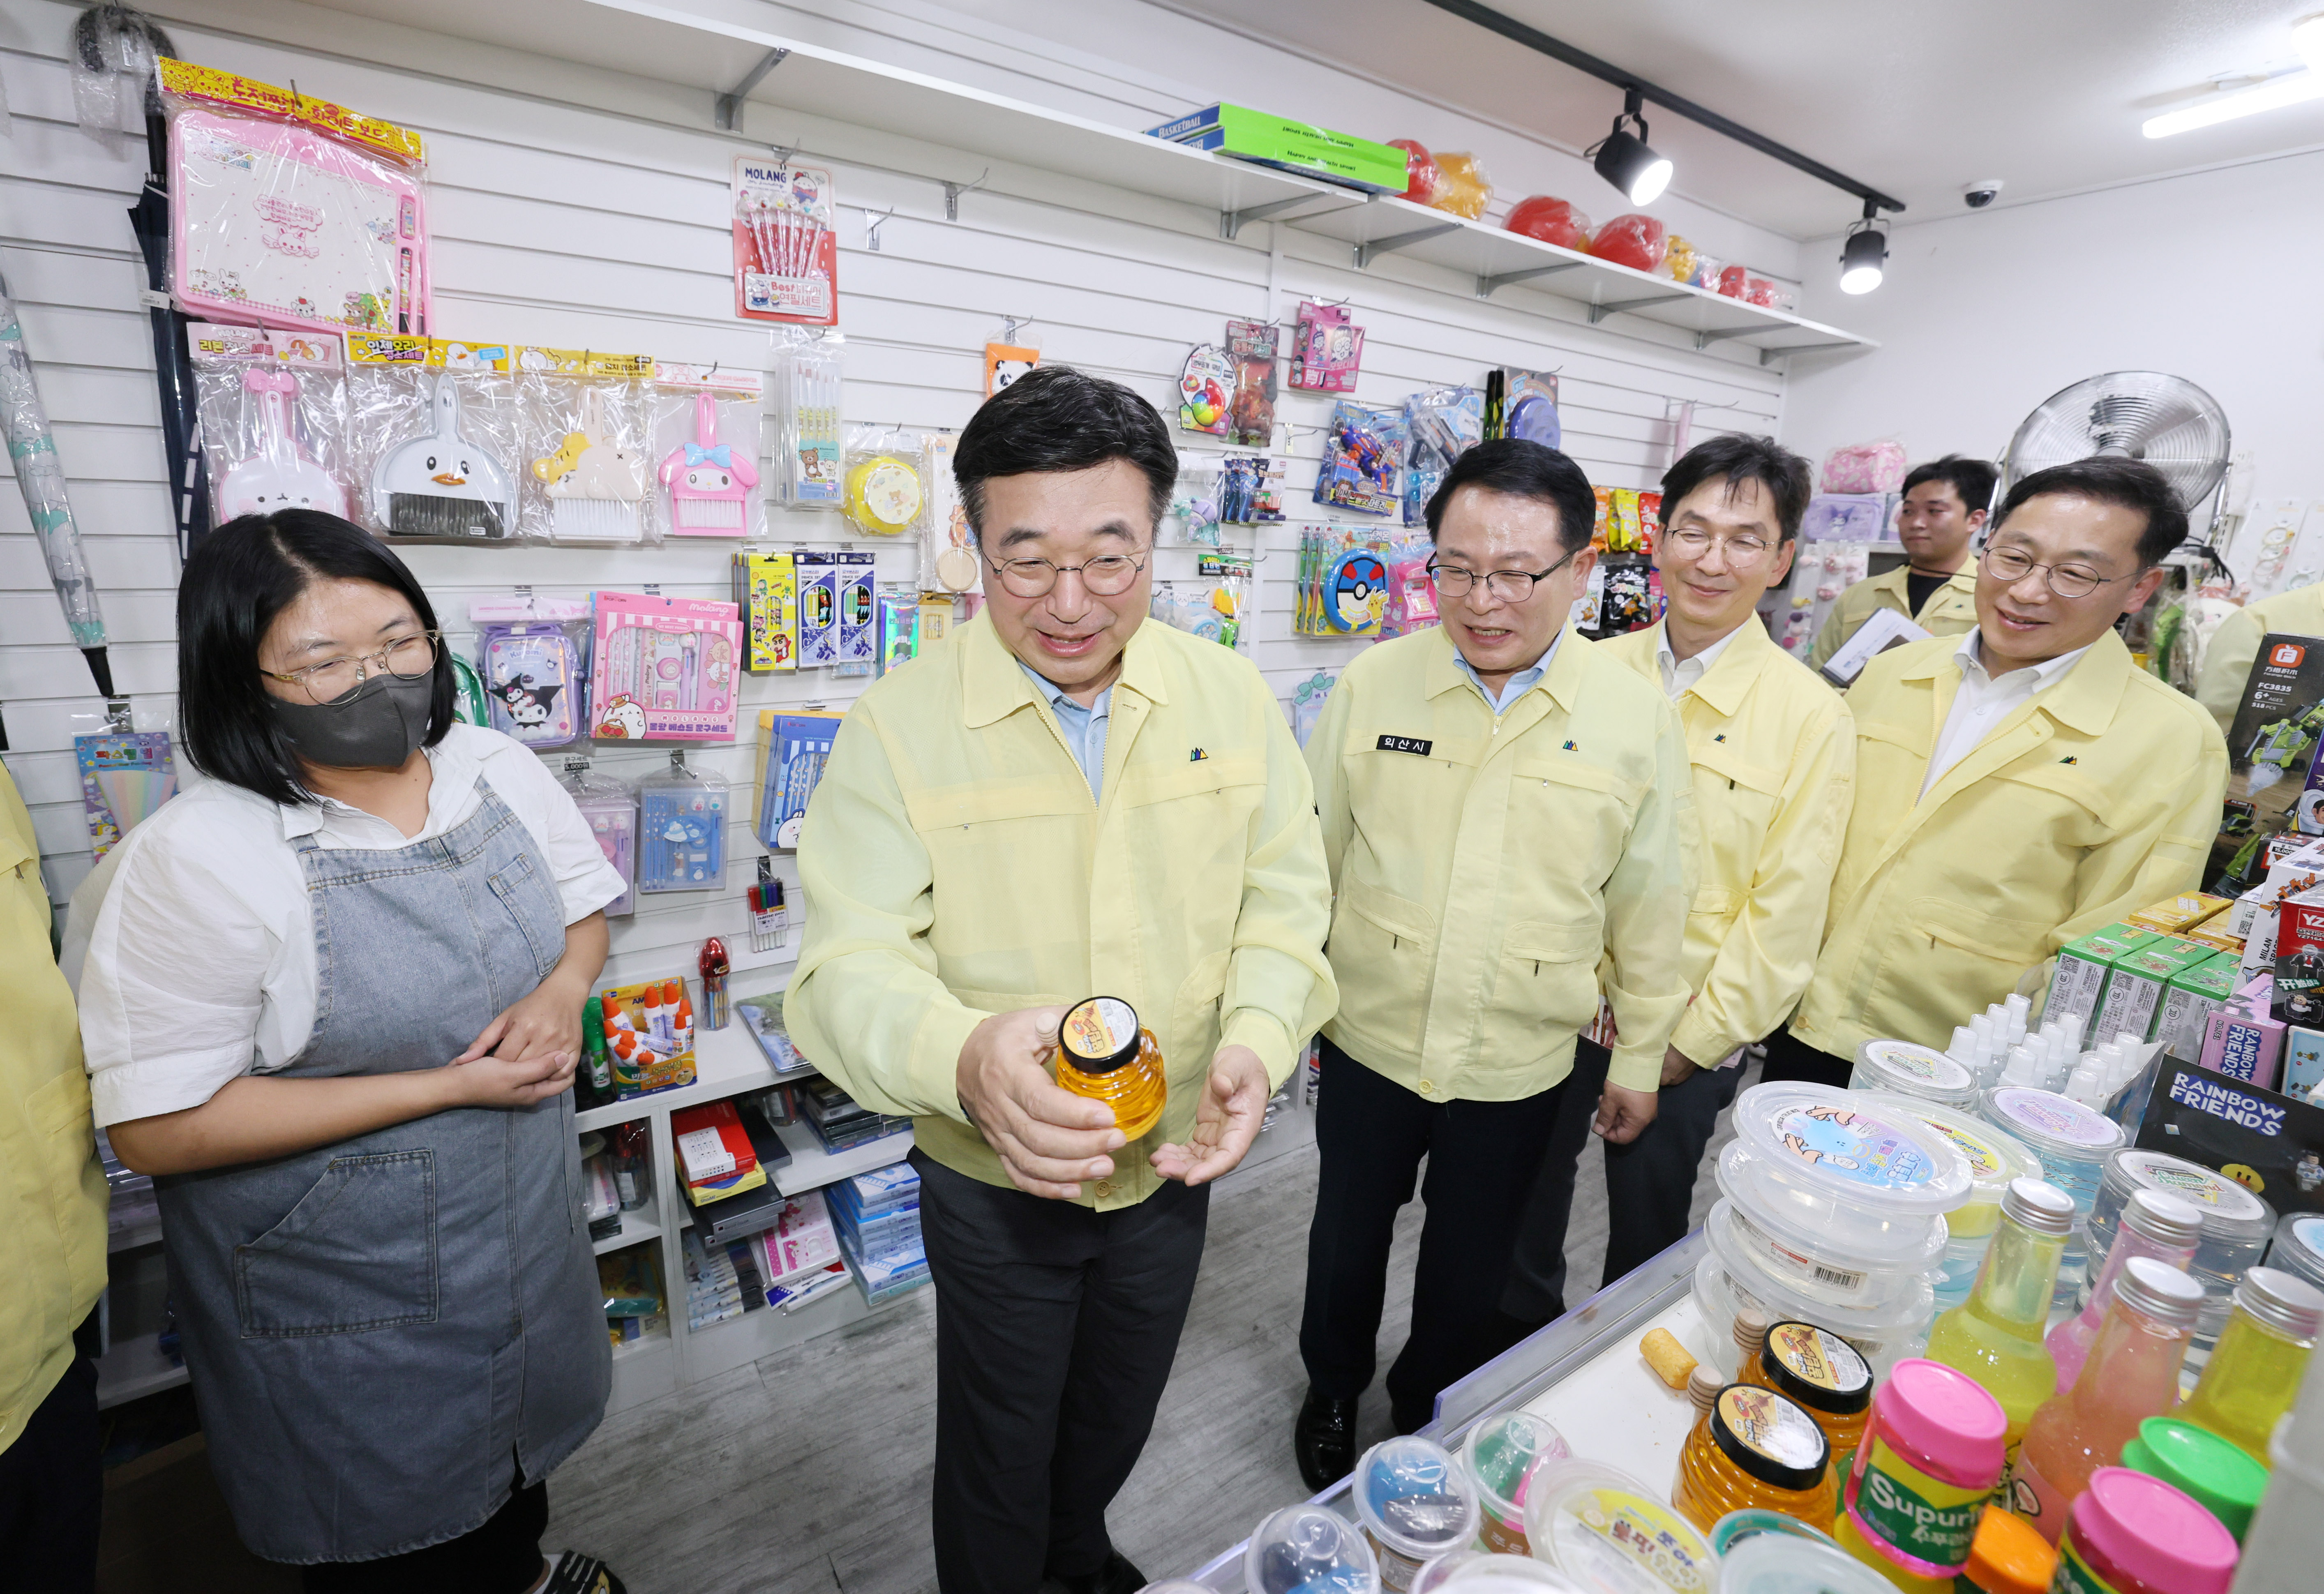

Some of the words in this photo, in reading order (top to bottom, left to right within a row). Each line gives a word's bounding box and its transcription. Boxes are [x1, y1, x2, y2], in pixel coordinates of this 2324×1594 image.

[745, 167, 787, 183] MOLANG
[771, 281, 795, 292] Best
[780, 292, 822, 308] 연필세트
[199, 339, 224, 354] 리본
[251, 344, 274, 355] 세트
[1368, 530, 1389, 542] 포켓몬
[689, 603, 729, 617] Molang
[510, 648, 543, 658] Kuromi
[2257, 682, 2292, 692] FC3835
[649, 722, 667, 731] 몰랑
[695, 724, 728, 733] 문구세트
[1384, 737, 1424, 752] 익산시
[2297, 933, 2324, 941] YZ7164-
[2259, 937, 2273, 961] MILAN
[2213, 1020, 2224, 1040] NO.761
[2222, 1024, 2244, 1077] FRIENDS
[2237, 1028, 2260, 1081] RAINBOW
[2174, 1071, 2287, 1120] RAINBOW
[2169, 1084, 2282, 1136] FRIENDS
[2156, 1170, 2210, 1184] Queen
